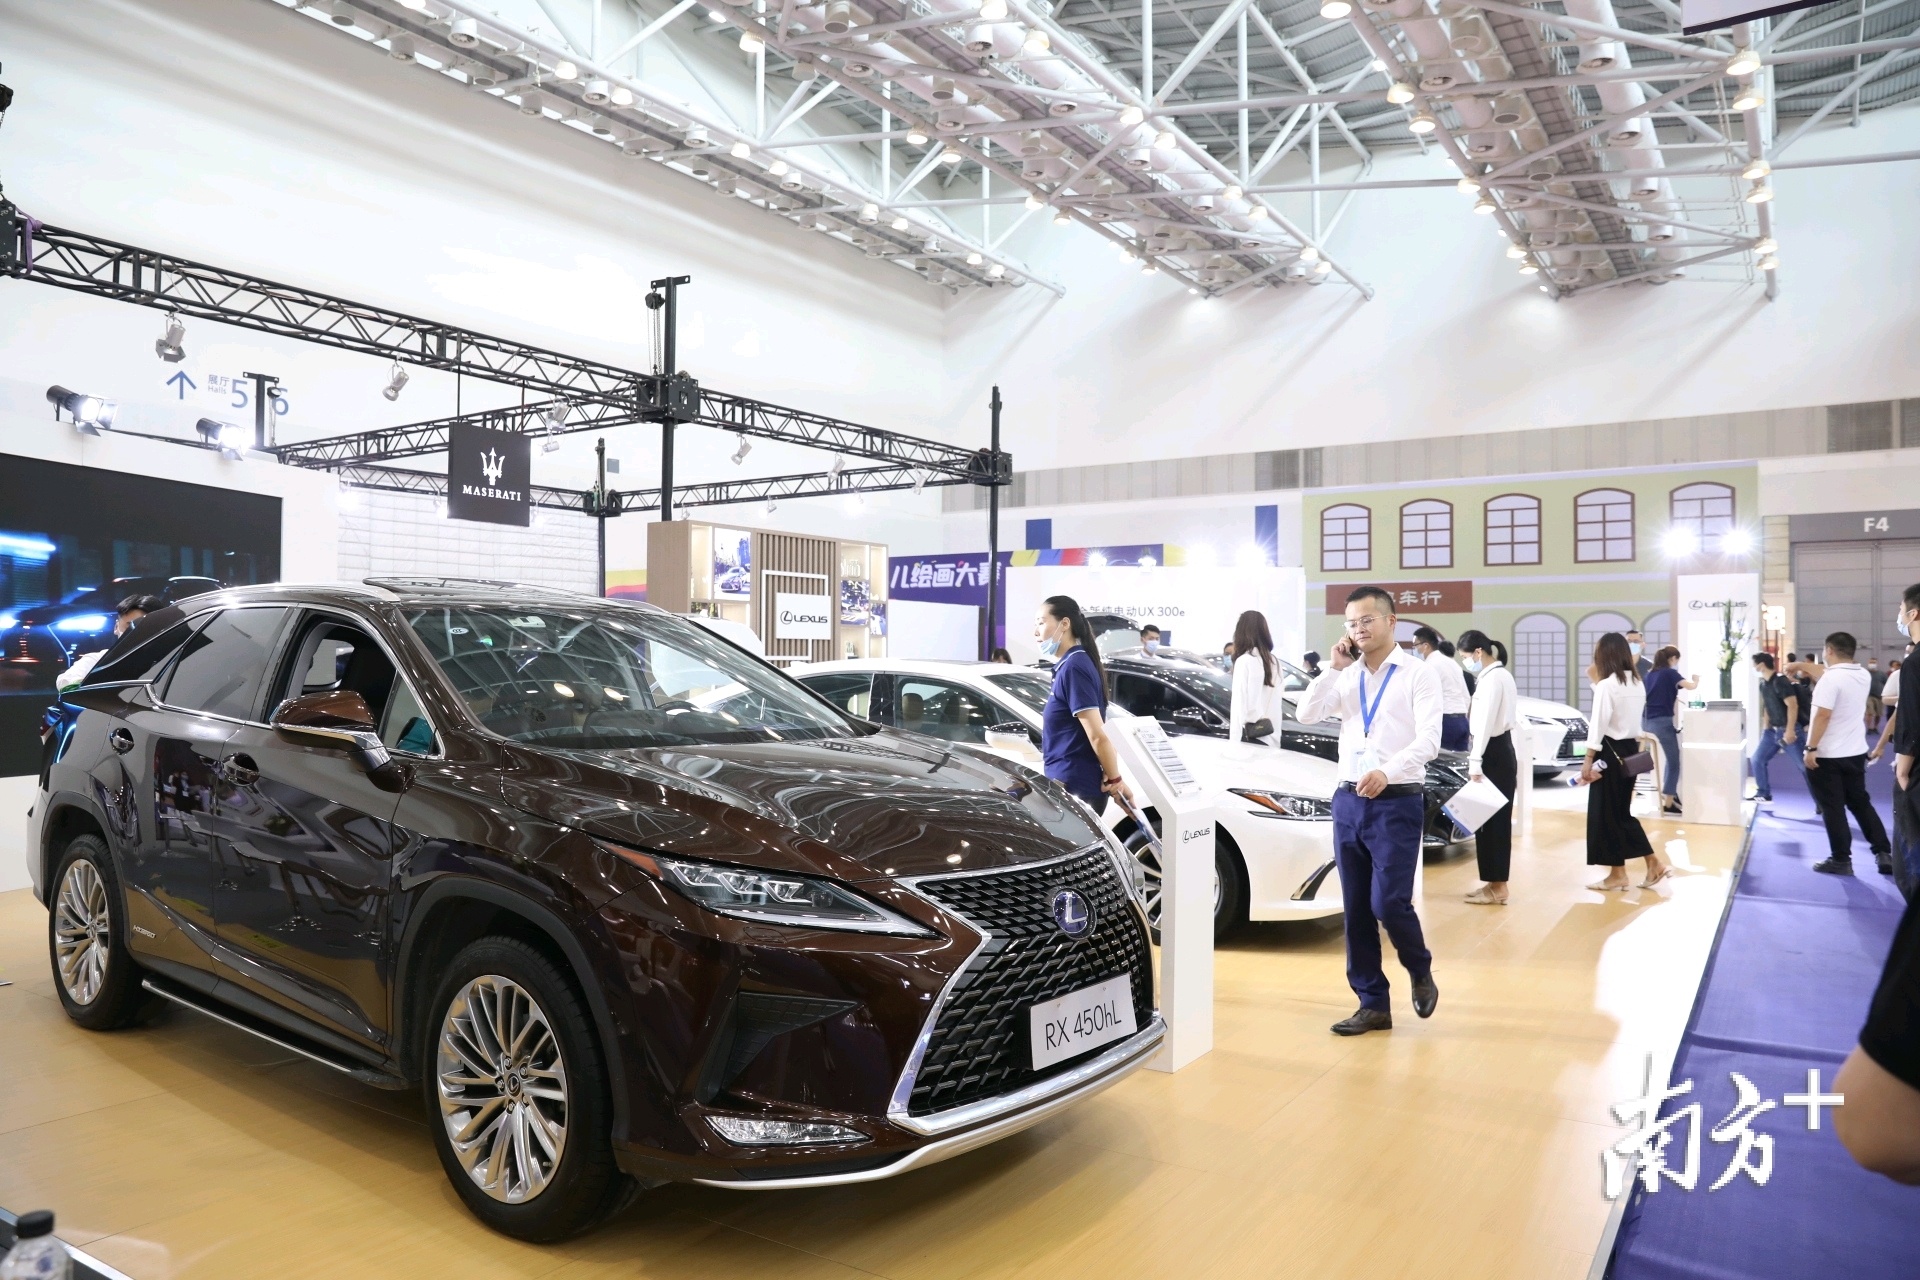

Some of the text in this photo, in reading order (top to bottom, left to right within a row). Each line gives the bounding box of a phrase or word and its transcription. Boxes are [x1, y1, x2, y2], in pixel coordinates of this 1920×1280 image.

[208, 374, 230, 386] 展厅
[208, 385, 226, 394] Halls
[462, 484, 521, 501] MASERATI
[1863, 516, 1889, 533] F4
[1157, 606, 1185, 617] 300e
[793, 614, 828, 624] LEXUS
[1190, 827, 1210, 839] LEXUS
[1045, 1000, 1122, 1051] RX 450hL
